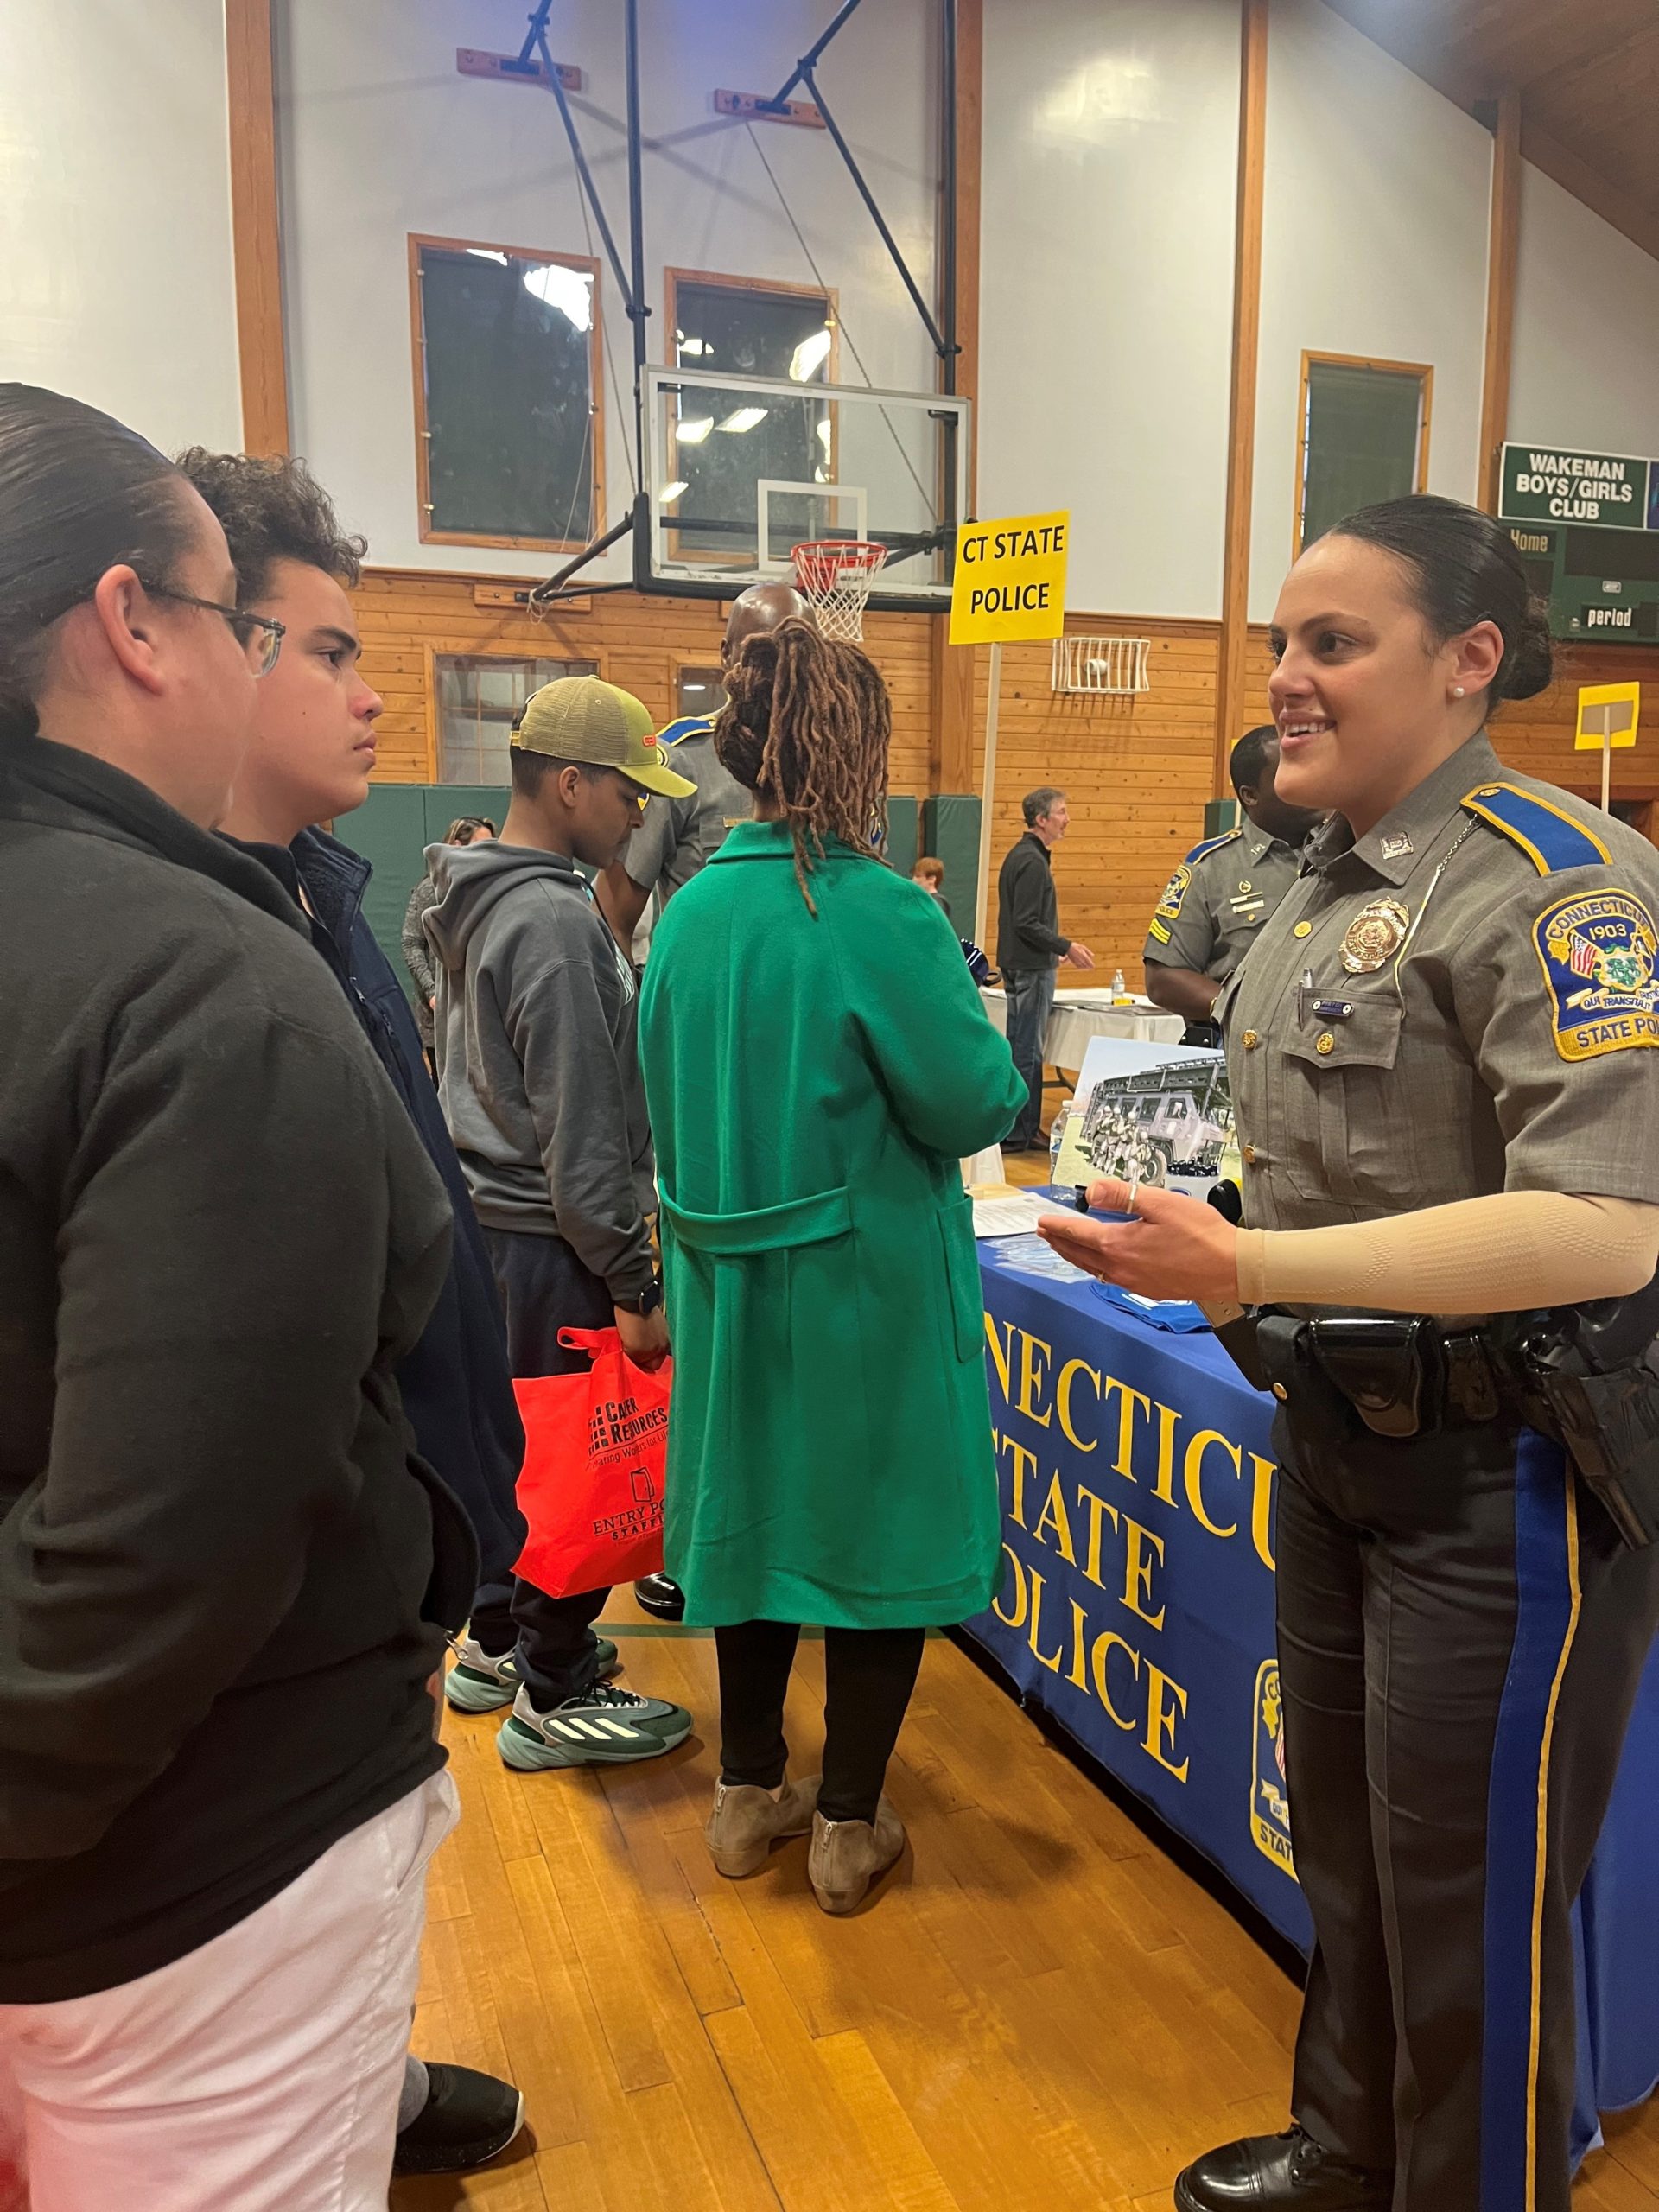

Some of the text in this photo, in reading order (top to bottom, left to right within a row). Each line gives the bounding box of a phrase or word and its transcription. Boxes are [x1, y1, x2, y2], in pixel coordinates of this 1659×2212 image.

[1529, 453, 1624, 480] WAKEMAN
[1516, 474, 1632, 503] BOYS/GIRLS
[1549, 498, 1599, 519] CLUB
[963, 525, 1064, 563] CT STATE
[1510, 528, 1548, 552] Home
[971, 582, 1049, 614] POLICE
[1587, 607, 1632, 628] period
[1548, 899, 1647, 938] CONNECTICUT
[1589, 923, 1627, 940] 1903
[1577, 1020, 1632, 1047] STATE
[593, 1506, 645, 1535] ENTRY
[992, 1427, 1165, 1632] TATE
